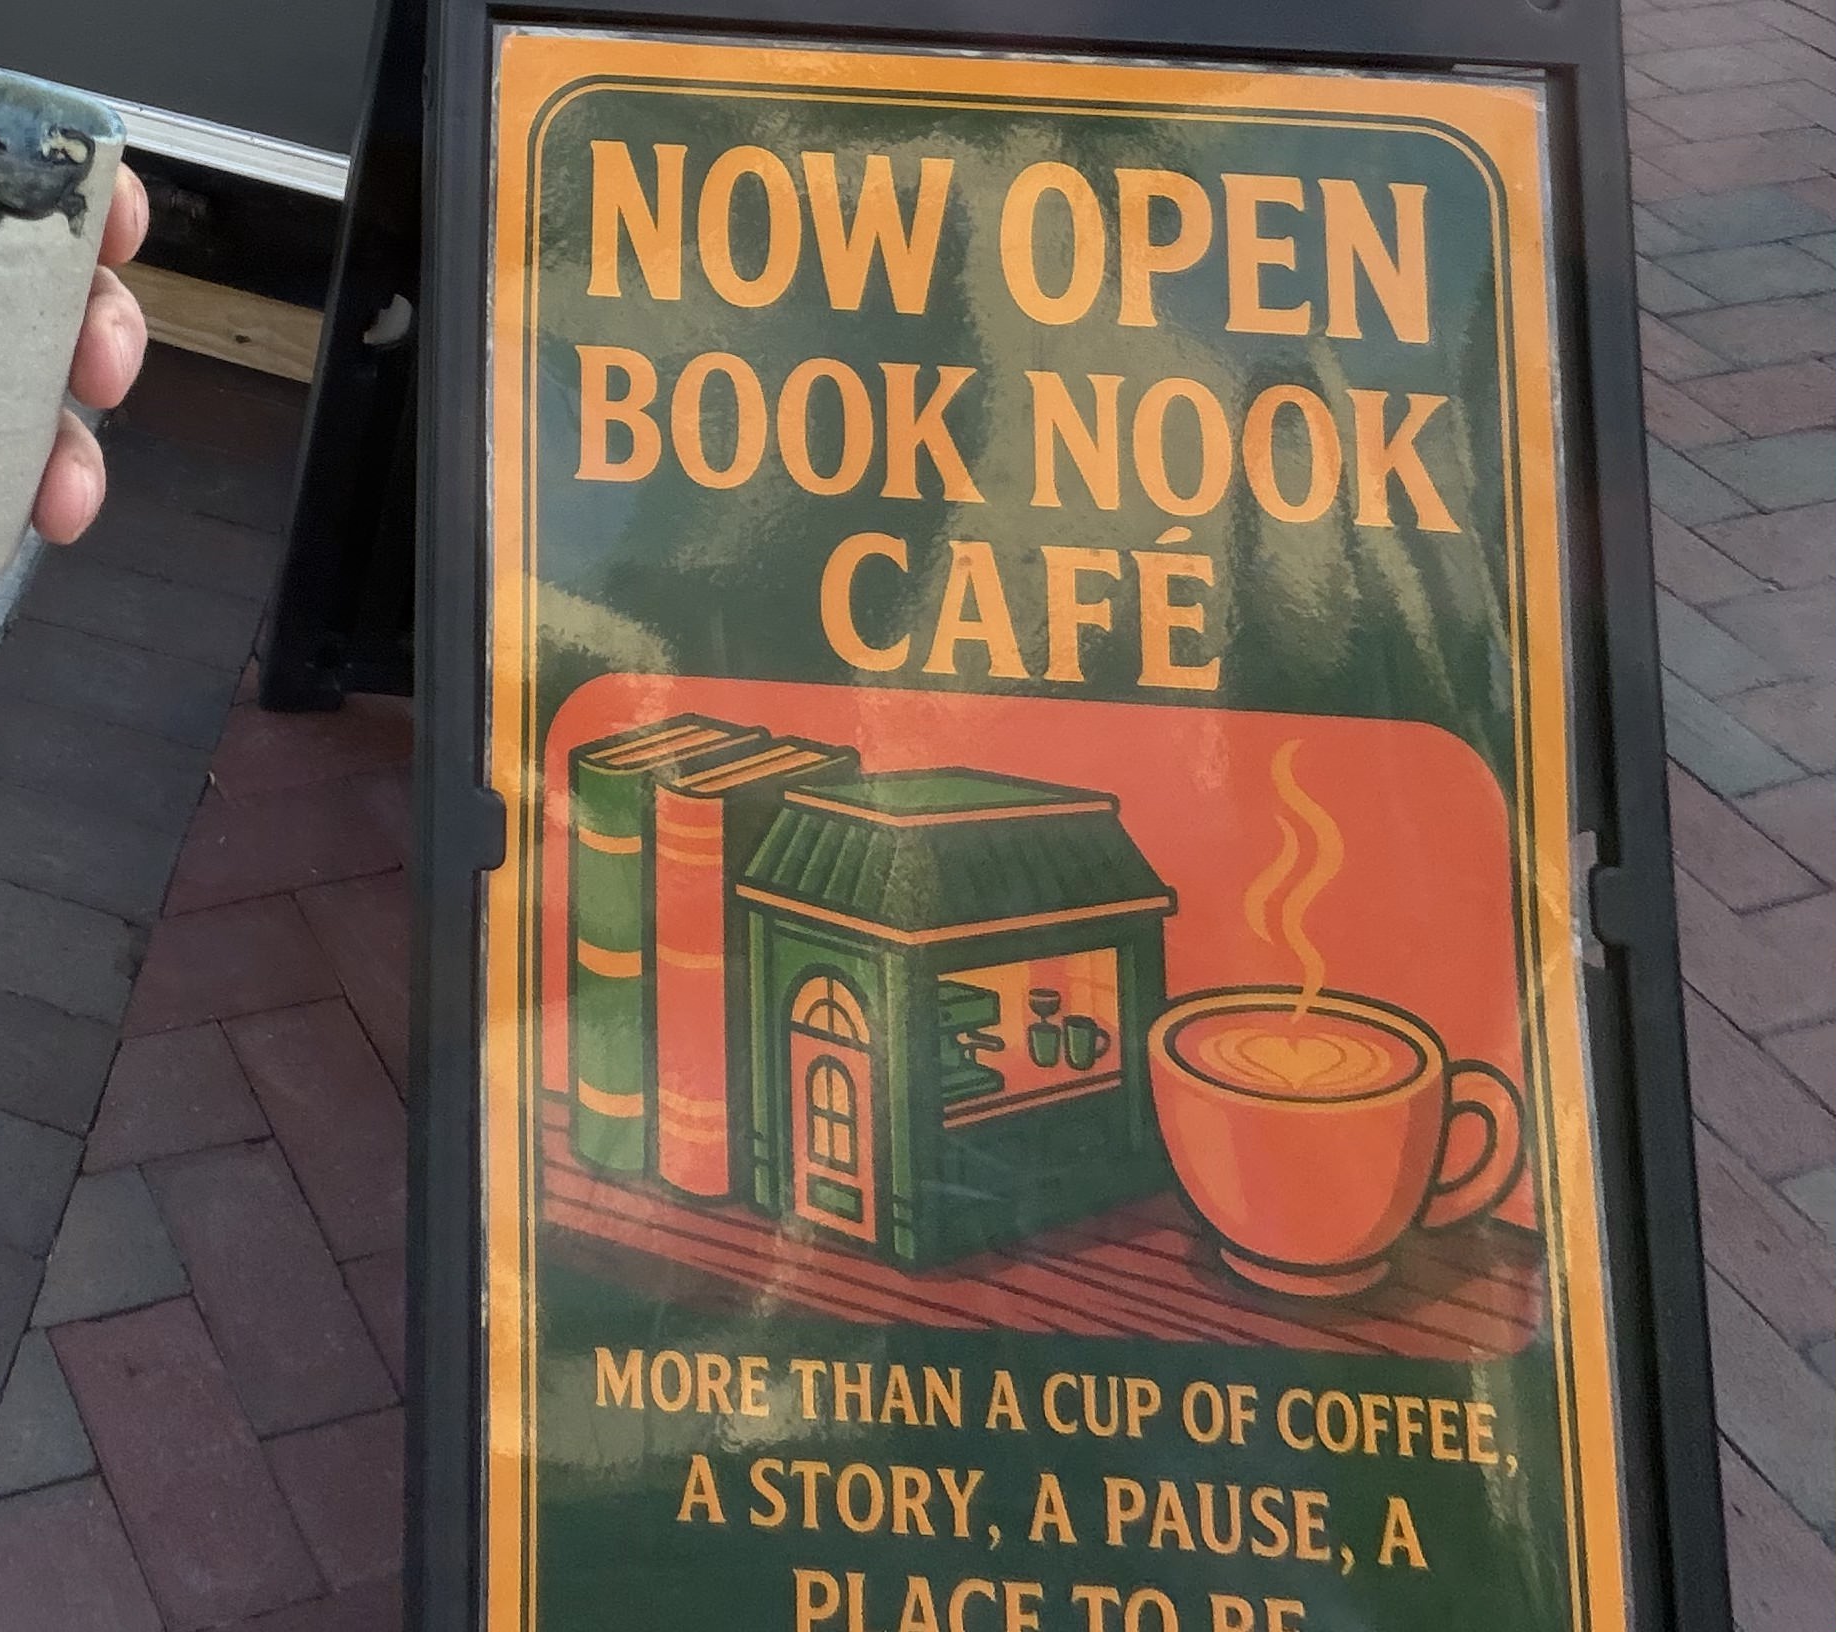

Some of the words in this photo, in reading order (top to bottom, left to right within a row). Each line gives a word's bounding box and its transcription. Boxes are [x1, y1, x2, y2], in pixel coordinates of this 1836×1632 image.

[585, 138, 956, 315] NOW
[997, 160, 1431, 344] OPEN
[574, 343, 987, 504] BOOK
[1022, 368, 1462, 534] NOOK
[819, 524, 1222, 692] CAFÉ
[594, 1346, 770, 1422] MORE
[789, 1358, 963, 1429] THAN
[985, 1369, 1026, 1431] A
[1042, 1372, 1162, 1439] CUP
[1181, 1380, 1256, 1446] OF
[1275, 1387, 1519, 1474] COFFEE,
[677, 1453, 726, 1524] A
[749, 1457, 1002, 1551] STORY,
[1029, 1472, 1078, 1544] A
[1104, 1476, 1356, 1576] PAUSE,
[1378, 1496, 1430, 1570] A
[793, 1568, 1045, 1632] PLACE
[1071, 1584, 1181, 1632] TO
